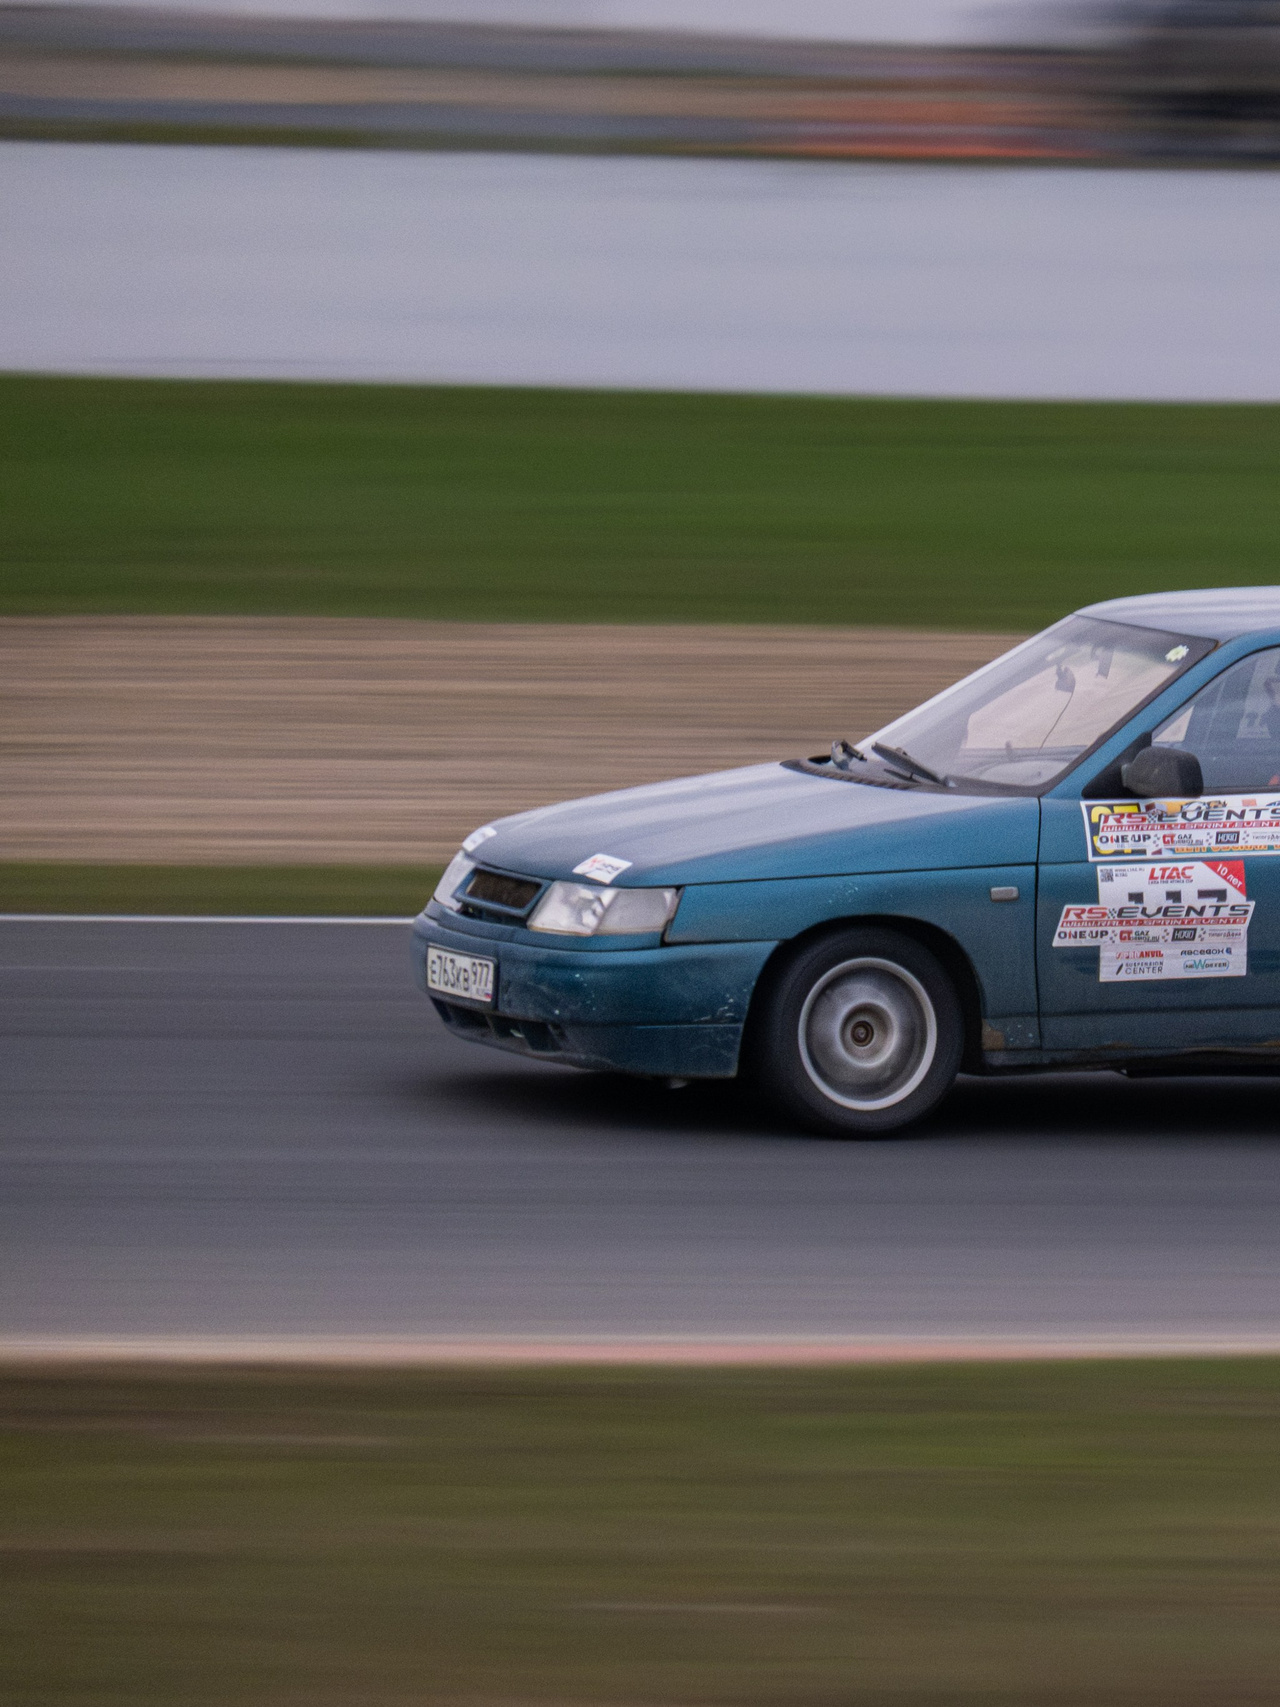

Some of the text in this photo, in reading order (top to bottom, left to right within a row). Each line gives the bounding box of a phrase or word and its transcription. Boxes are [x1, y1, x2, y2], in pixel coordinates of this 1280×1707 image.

[1148, 866, 1194, 881] LTAC
[1216, 863, 1229, 877] 10
[1063, 904, 1251, 920] RS EVENTS
[472, 961, 490, 988] 977
[1125, 966, 1163, 975] CENTER
